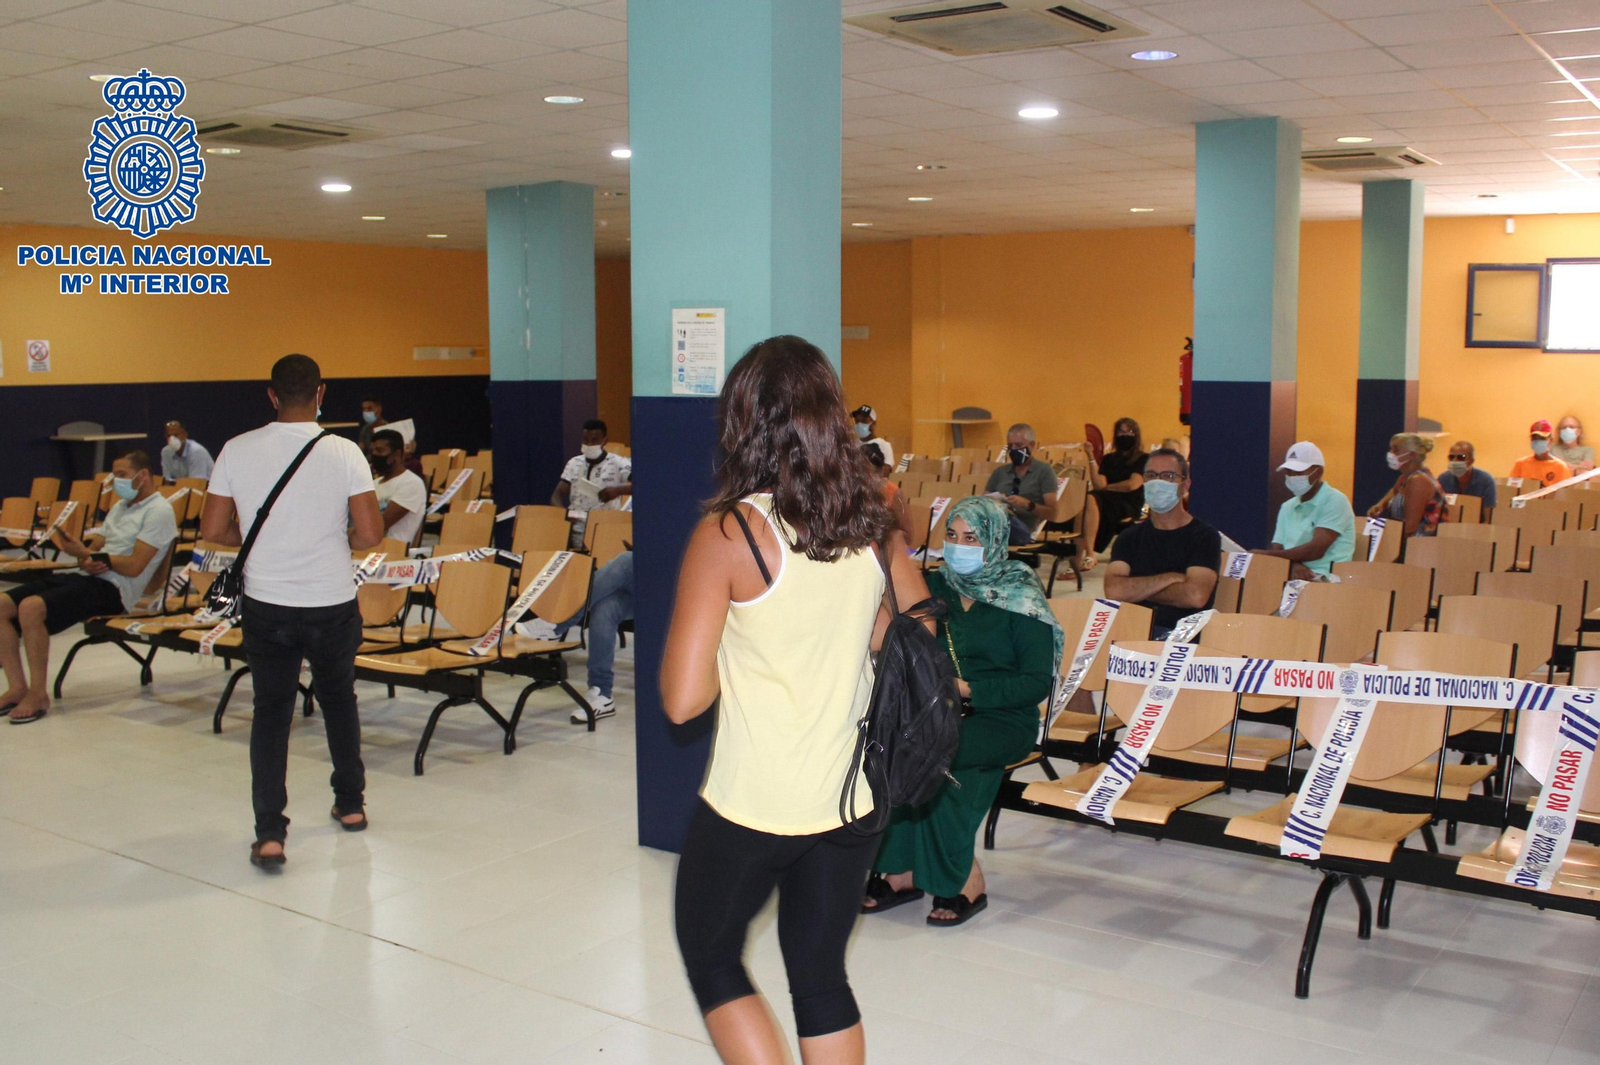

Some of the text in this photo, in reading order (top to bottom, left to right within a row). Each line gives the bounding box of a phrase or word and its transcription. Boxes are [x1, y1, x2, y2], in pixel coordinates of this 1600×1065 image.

[396, 565, 415, 578] PASAR
[1088, 611, 1111, 638] PASAR
[1083, 640, 1100, 651] NO
[1108, 654, 1146, 678] POLICIA
[1159, 645, 1189, 683] POLICIA
[1183, 663, 1218, 684] NACIO
[1222, 666, 1232, 685] C.
[1274, 668, 1514, 701] C. NACIONAL DE POLICIA NO PASAR
[1572, 692, 1595, 704] C.
[1142, 703, 1163, 718] NO
[1124, 718, 1155, 749] PASAR
[1300, 709, 1363, 819] C. NACIONAL DE POLICIA
[1557, 749, 1583, 791] PASAR
[1103, 775, 1122, 786] C.
[1546, 792, 1571, 812] NO
